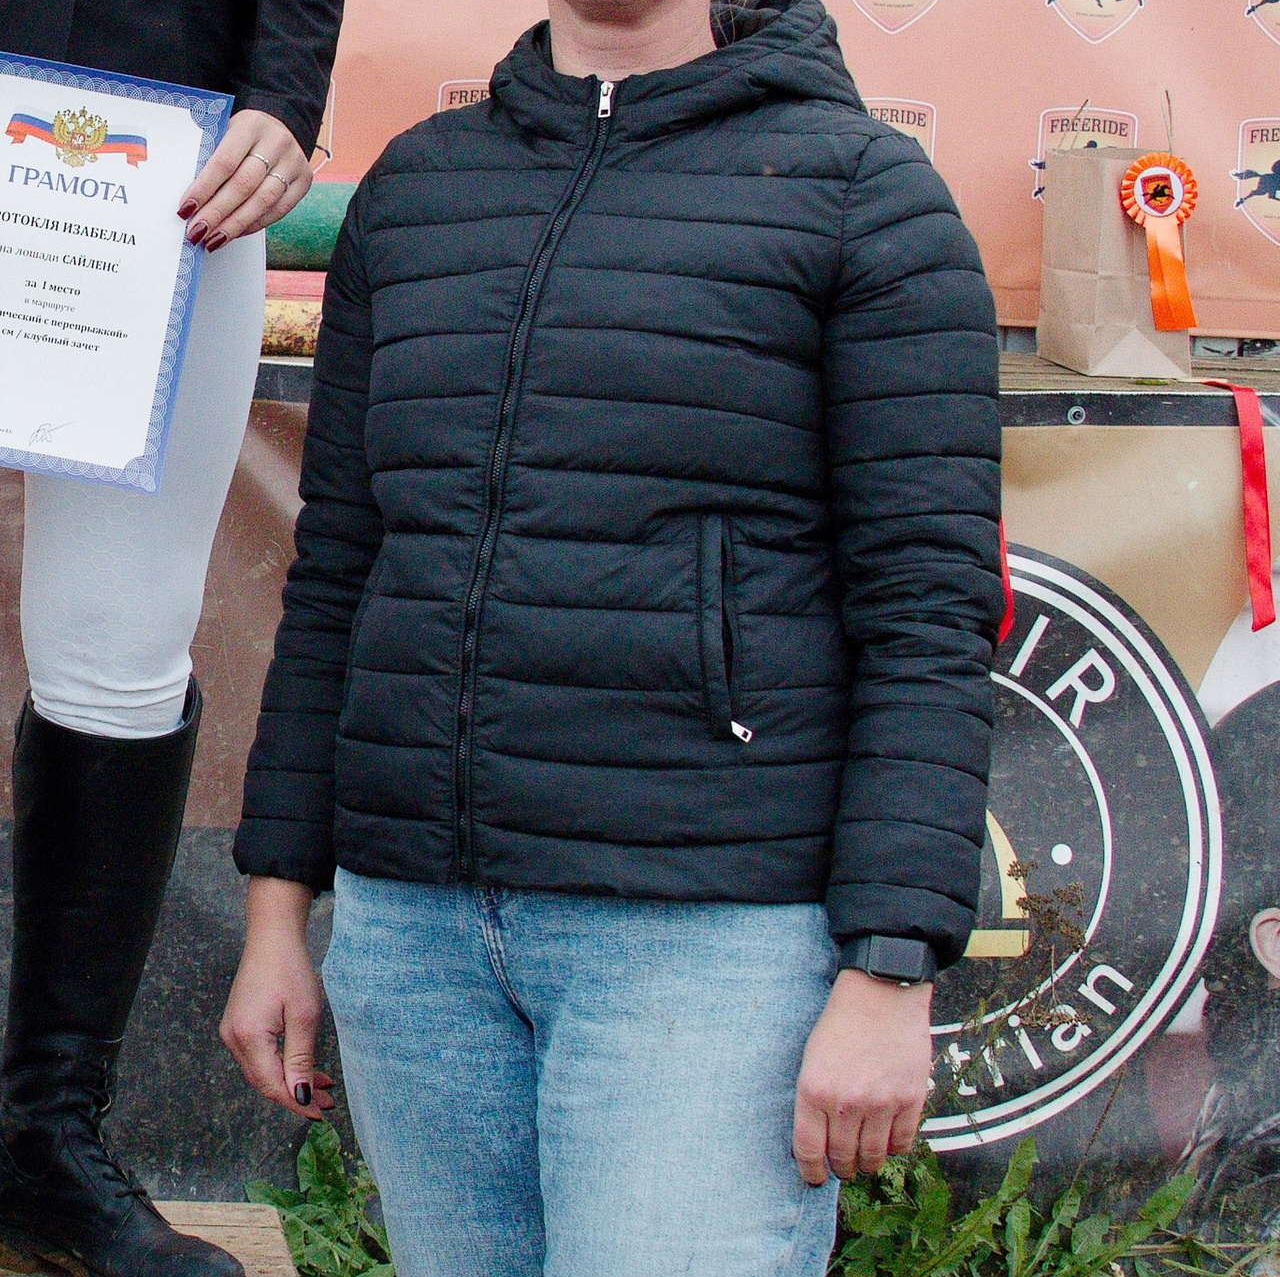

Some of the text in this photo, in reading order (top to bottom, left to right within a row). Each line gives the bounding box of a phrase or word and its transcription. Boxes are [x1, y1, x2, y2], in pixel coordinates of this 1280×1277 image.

[448, 88, 489, 106] FREE
[869, 107, 927, 126] EERIDE
[1050, 118, 1128, 137] FREERIDE
[8, 164, 128, 204] ГРАМОТА
[63, 222, 137, 246] ИЗАБЕЛЛА
[0, 244, 120, 274] на лошади САЙЛЕНС
[24, 279, 37, 288] за
[49, 284, 81, 296] место
[32, 299, 75, 313] маршруте
[51, 320, 128, 339] перепрыжкой»
[2, 328, 14, 336] см
[24, 332, 69, 347] клубный
[70, 340, 100, 352] зачет
